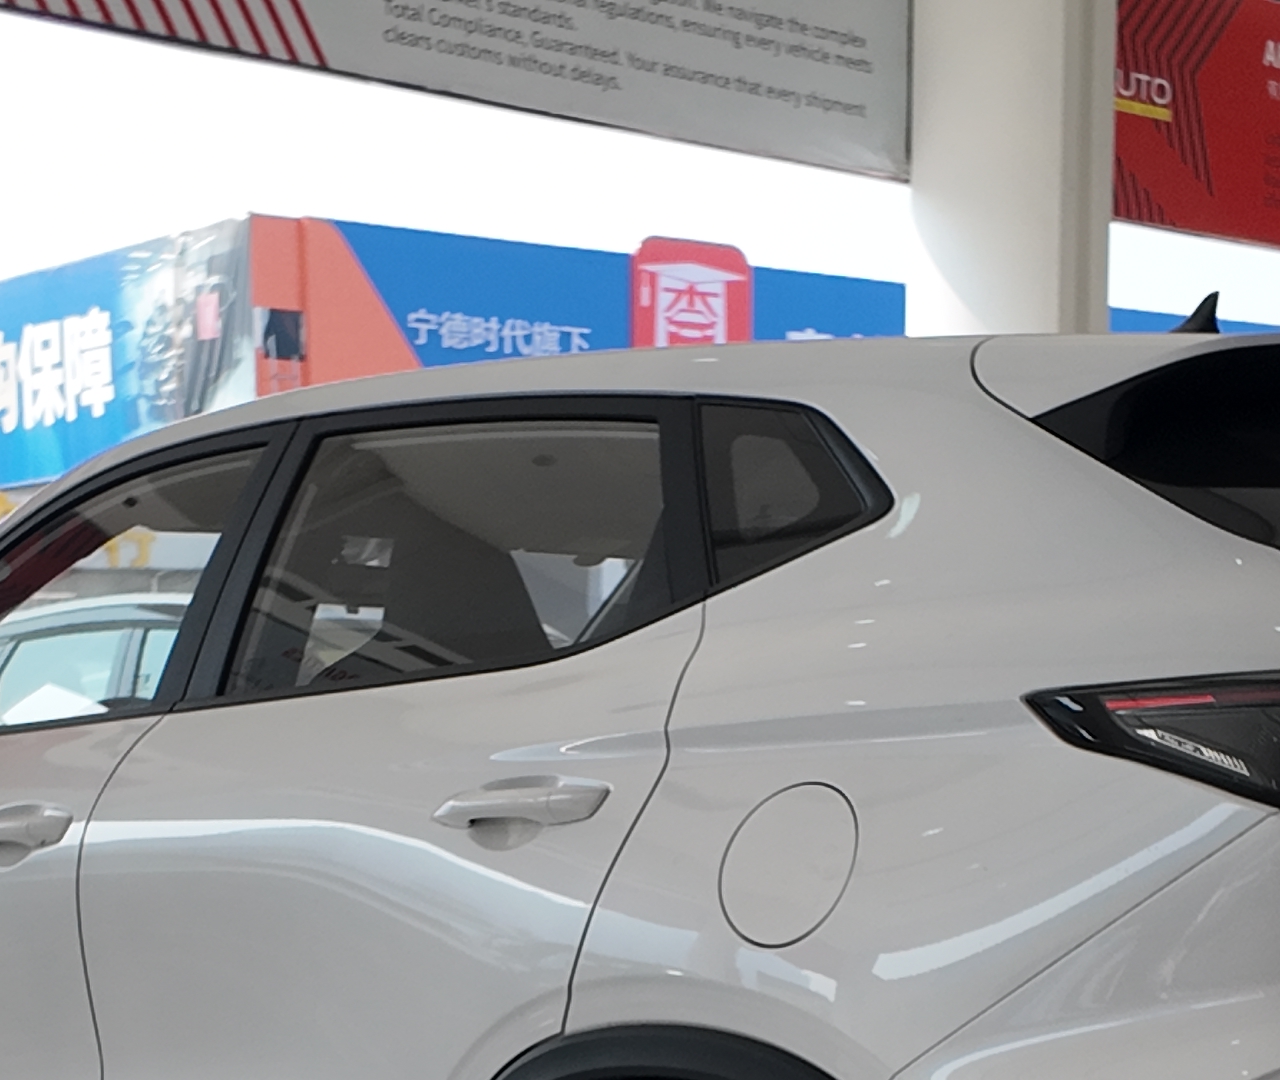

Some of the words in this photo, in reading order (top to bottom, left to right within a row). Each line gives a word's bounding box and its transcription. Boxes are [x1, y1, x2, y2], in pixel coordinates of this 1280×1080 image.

[383, 25, 433, 50] clears
[435, 39, 504, 65] customs
[506, 54, 566, 79] without
[680, 18, 742, 50] ensuring
[745, 33, 782, 58] every
[786, 17, 809, 37] the
[811, 25, 867, 49] complex
[662, 62, 730, 89] assurance
[735, 76, 762, 96] that
[766, 85, 801, 109] every
[804, 92, 866, 118] shipment
[1116, 69, 1173, 105] UTO
[407, 308, 592, 356] 宁德时代旗下
